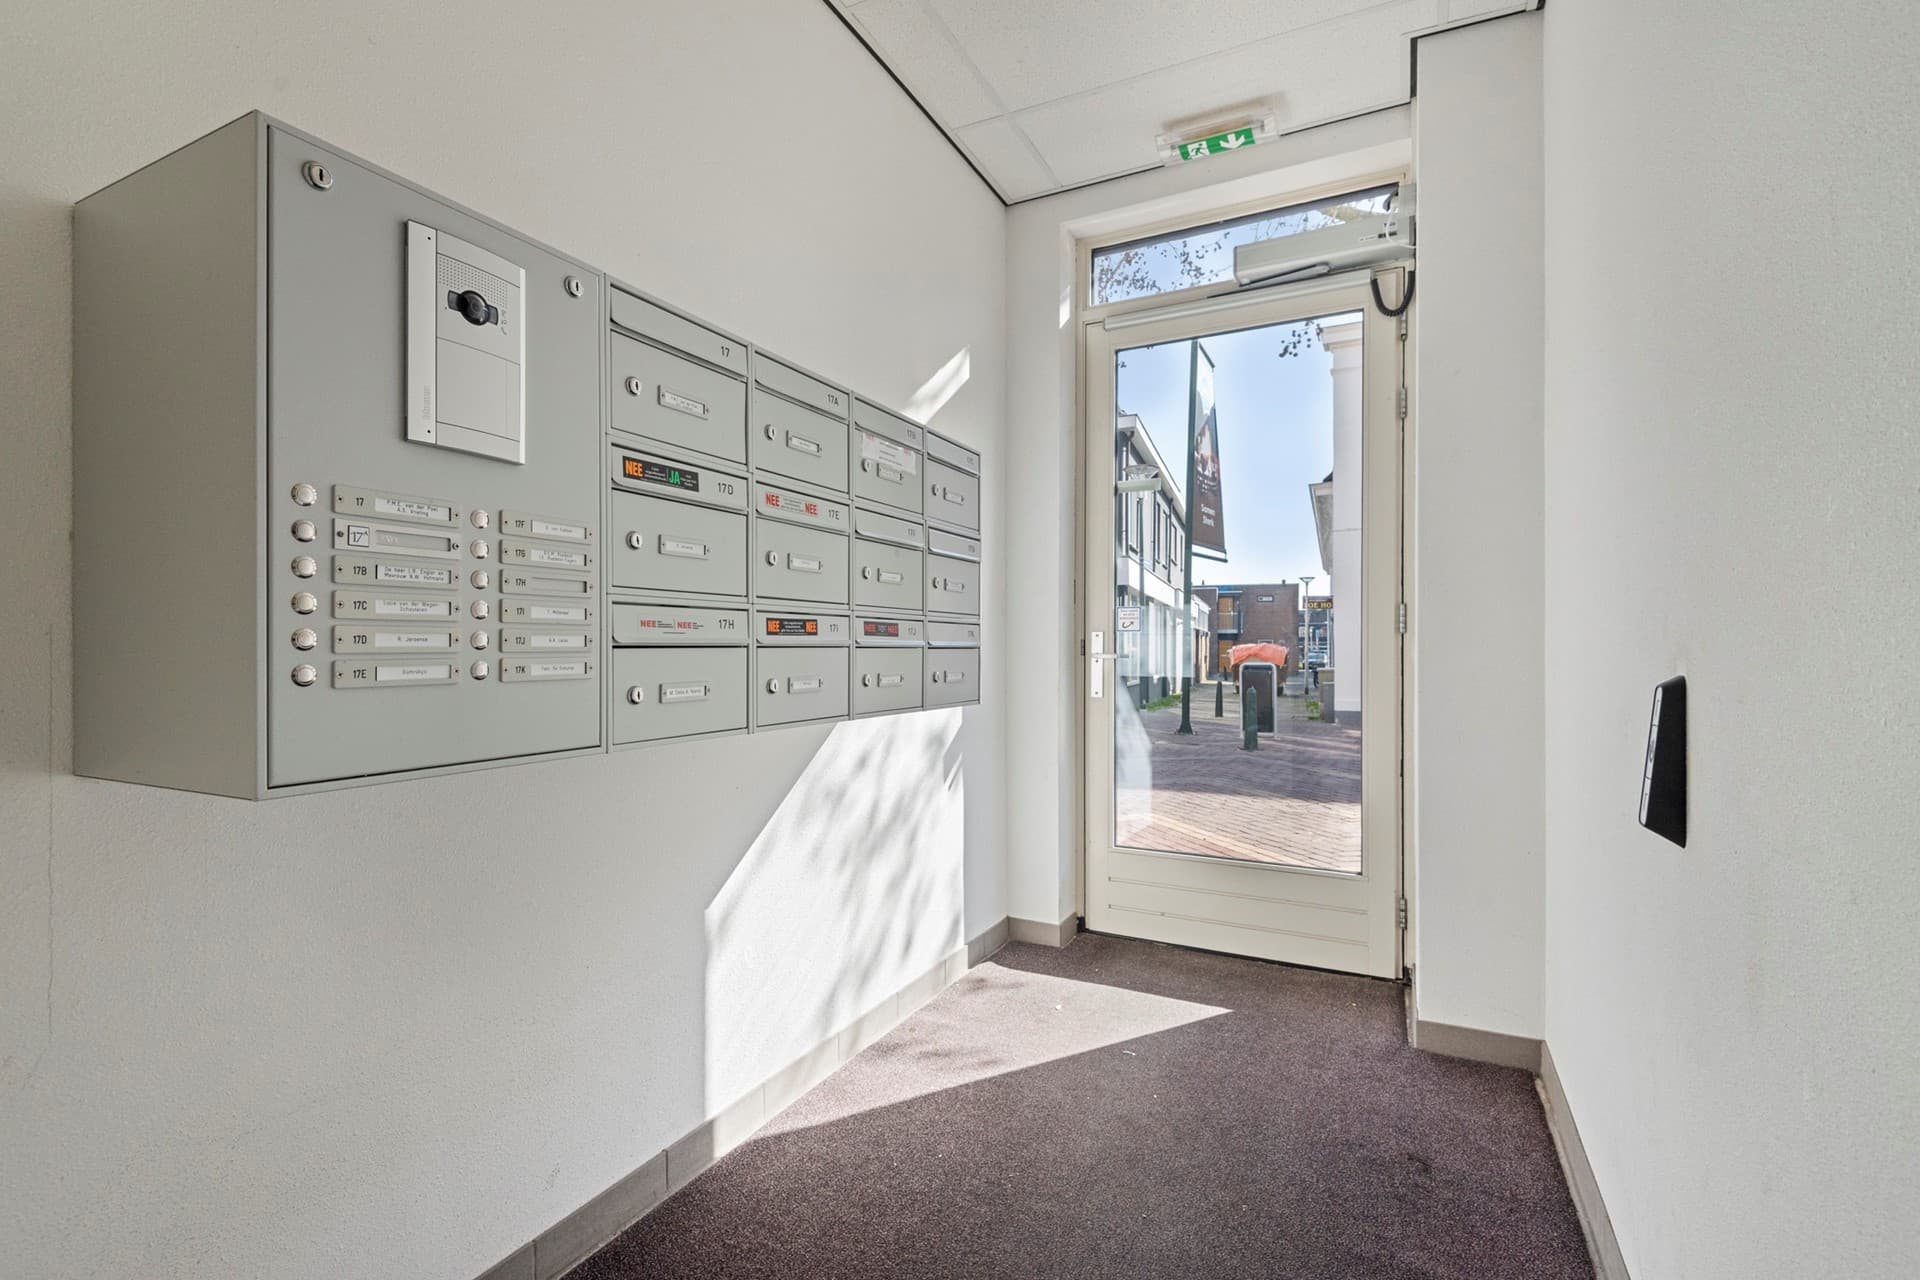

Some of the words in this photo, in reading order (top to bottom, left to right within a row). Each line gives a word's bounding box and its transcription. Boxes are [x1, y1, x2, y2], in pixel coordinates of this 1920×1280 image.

[721, 346, 730, 357] 17
[827, 394, 839, 407] 17A
[625, 460, 643, 477] NEE
[669, 470, 681, 485] JA
[718, 482, 734, 495] 17D
[356, 497, 364, 507] 17
[765, 493, 780, 507] NEE
[804, 502, 818, 516] NEE
[828, 509, 840, 520] 17E
[515, 519, 526, 529] 17F
[353, 565, 367, 576] 17B
[515, 578, 526, 587] 17H
[353, 600, 368, 610] 17C
[516, 607, 525, 616] 17I
[640, 619, 657, 628] NEE
[677, 621, 692, 629] NEE
[718, 619, 735, 630] 17H
[768, 619, 780, 633] NEE
[805, 620, 817, 633] NEE
[353, 634, 367, 645] 17D
[515, 636, 526, 646] 17J
[353, 669, 367, 679] 17E
[515, 665, 526, 675] 17K
